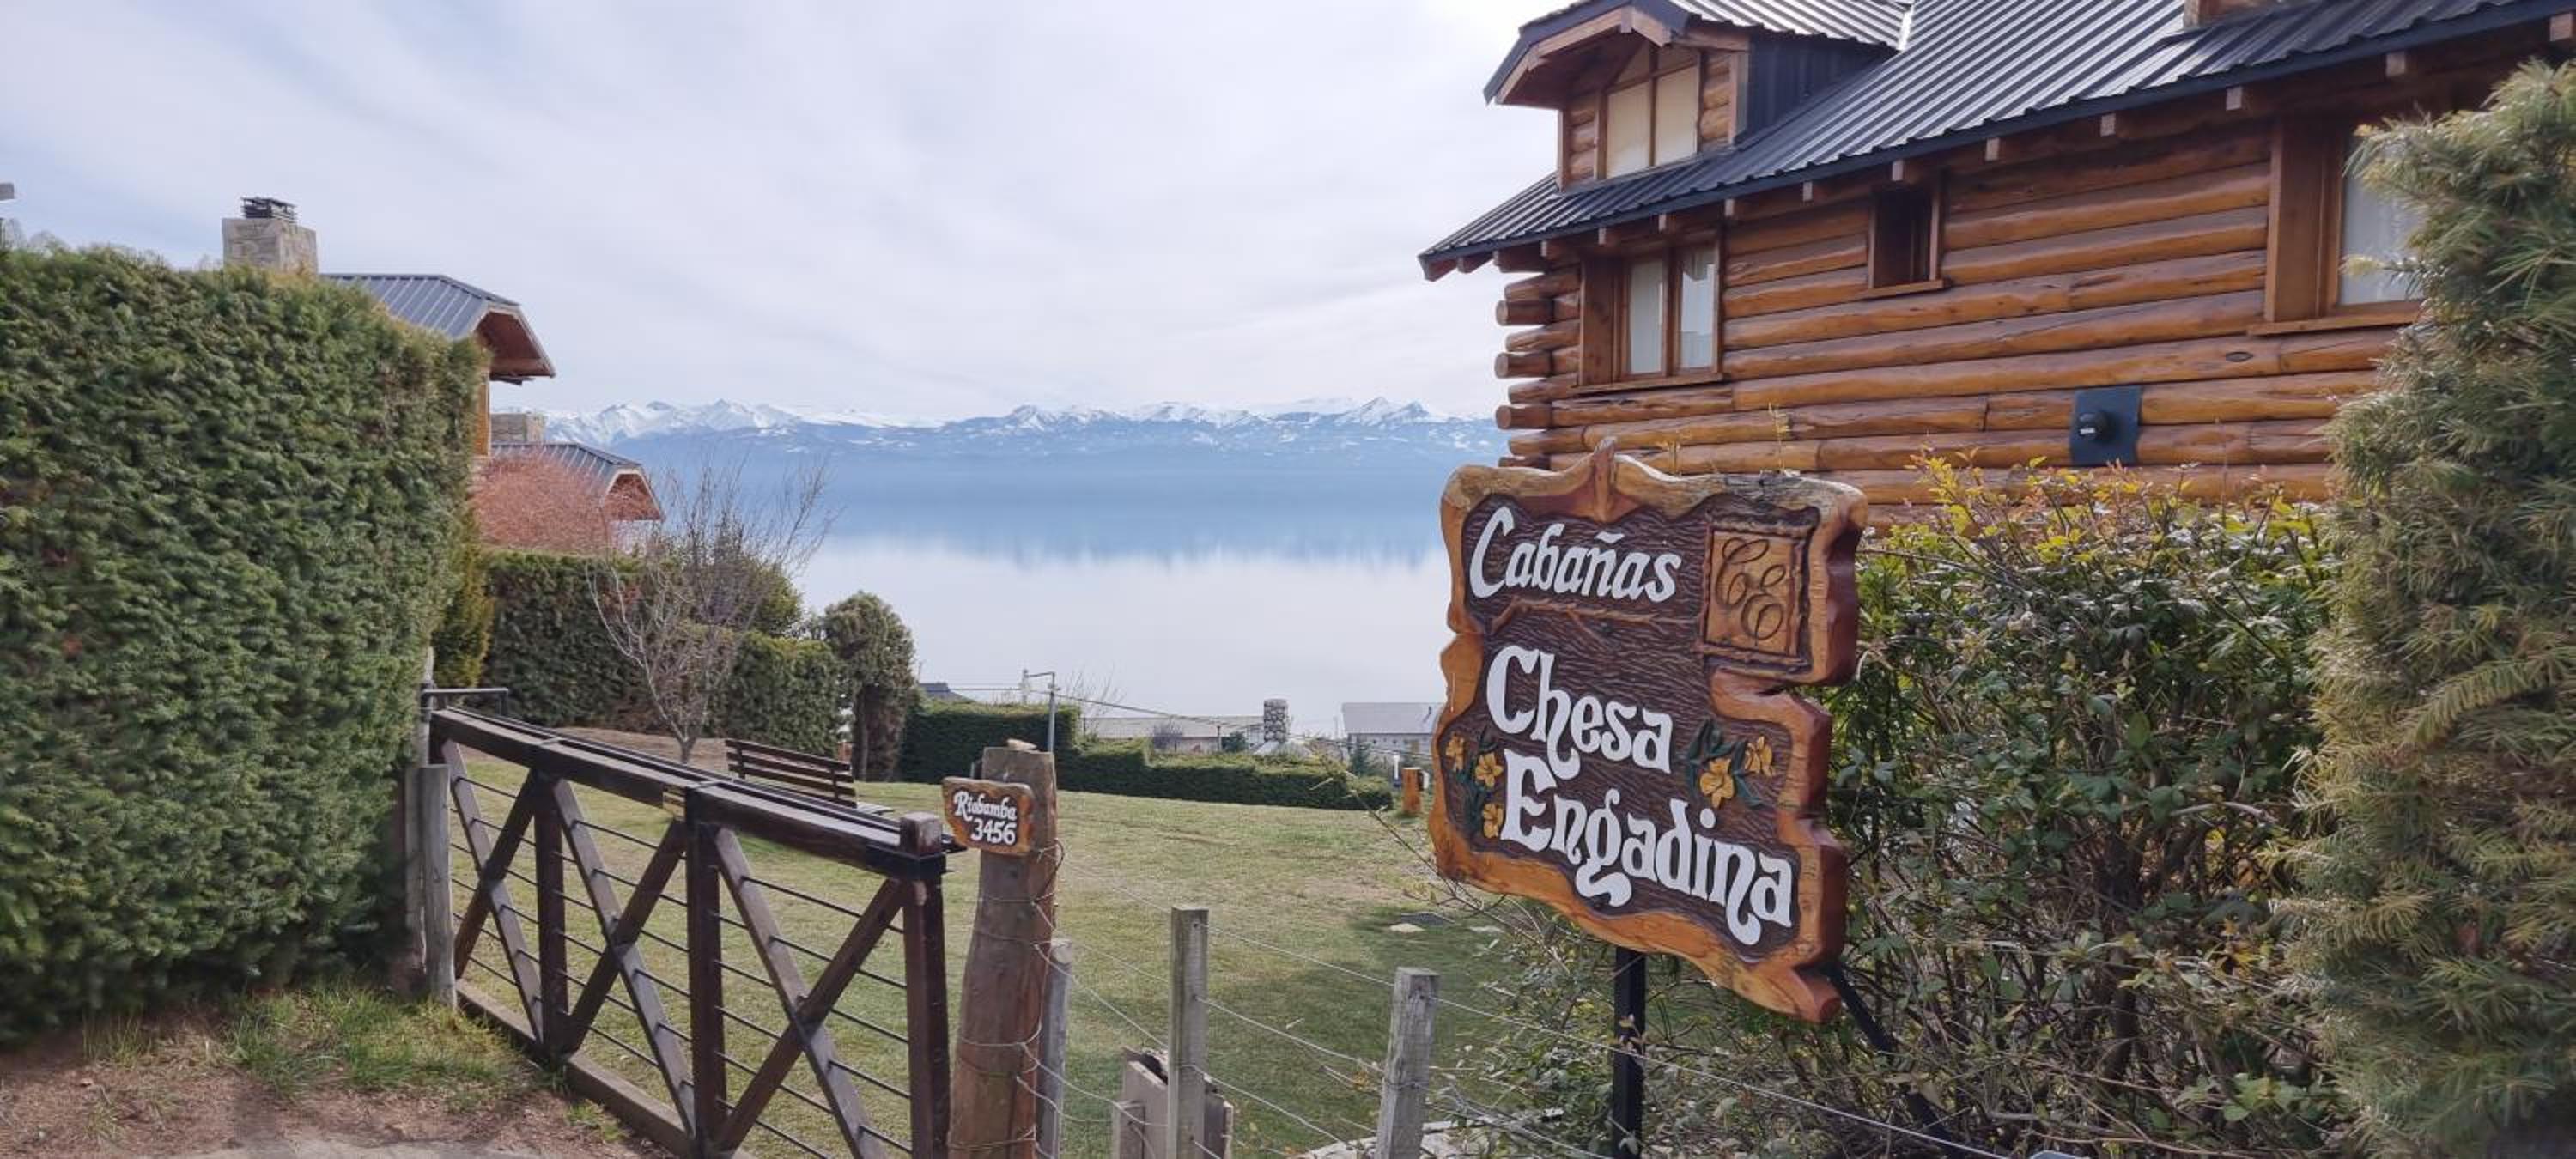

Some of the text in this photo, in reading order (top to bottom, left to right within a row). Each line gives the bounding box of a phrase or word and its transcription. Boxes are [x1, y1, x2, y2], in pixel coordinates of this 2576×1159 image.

[1469, 507, 1681, 602] Cabañas
[1486, 645, 1674, 780] Chesa
[953, 791, 1017, 822] Riobamba
[970, 817, 1017, 845] 3456
[1499, 749, 1793, 945] Engadina
